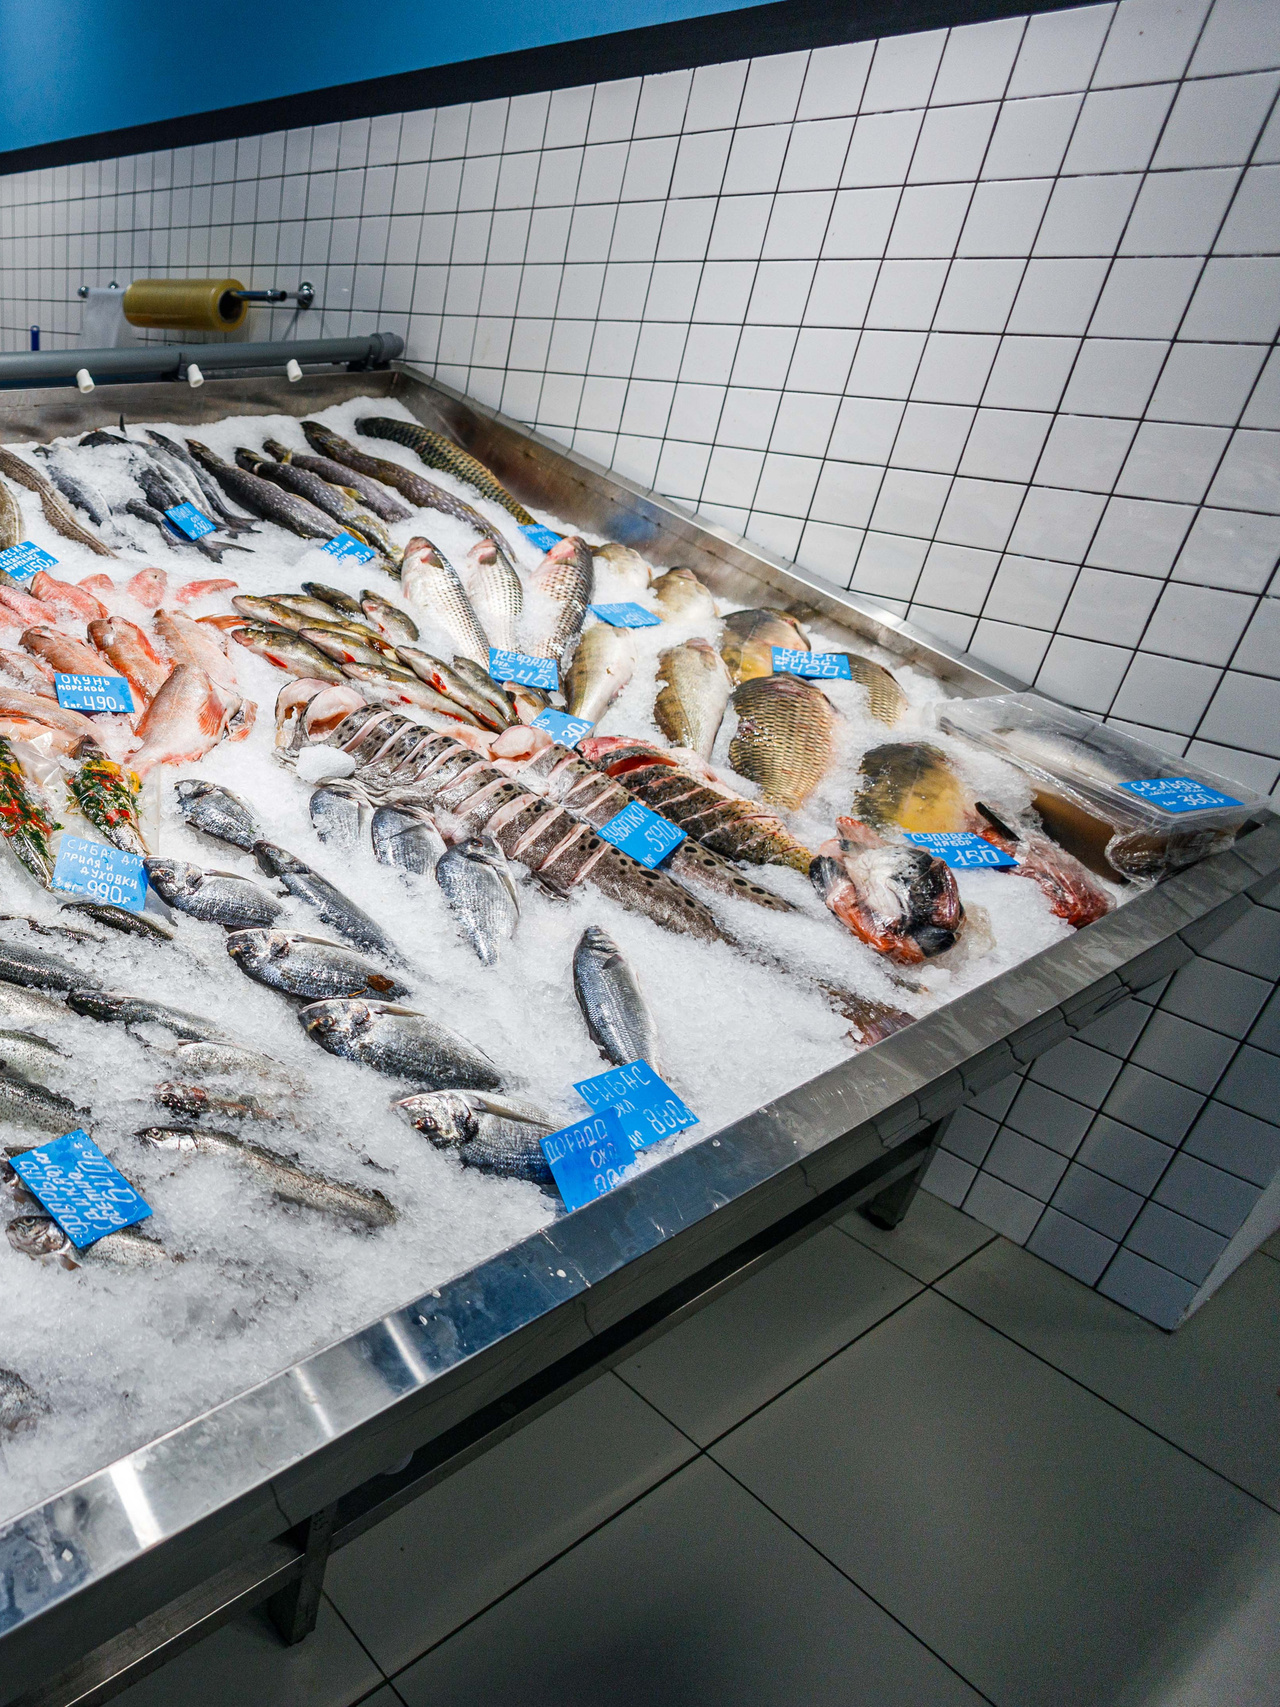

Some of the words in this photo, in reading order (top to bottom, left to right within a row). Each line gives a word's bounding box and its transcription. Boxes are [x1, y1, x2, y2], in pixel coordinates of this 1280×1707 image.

[5, 553, 40, 573] МУРМАНСК
[495, 650, 555, 669] КЕФАЛЬ
[782, 648, 837, 662] КАРП
[57, 684, 105, 692] МОРСКОЙ
[61, 674, 111, 686] ОКУНЬ
[601, 804, 649, 845] ЗУБАТКА
[911, 833, 978, 843] СУПОВОЙ
[62, 852, 101, 868] ГРИЛЯ
[67, 839, 117, 860] СИБАС
[121, 855, 144, 868] ДЛЯ
[954, 849, 1000, 866] 150
[80, 866, 138, 890] ДУХОВКИ
[580, 1065, 651, 1105] СИБАС
[544, 1119, 608, 1165] ДОРАДО
[19, 1160, 92, 1235] ФОРЕЛЬ
